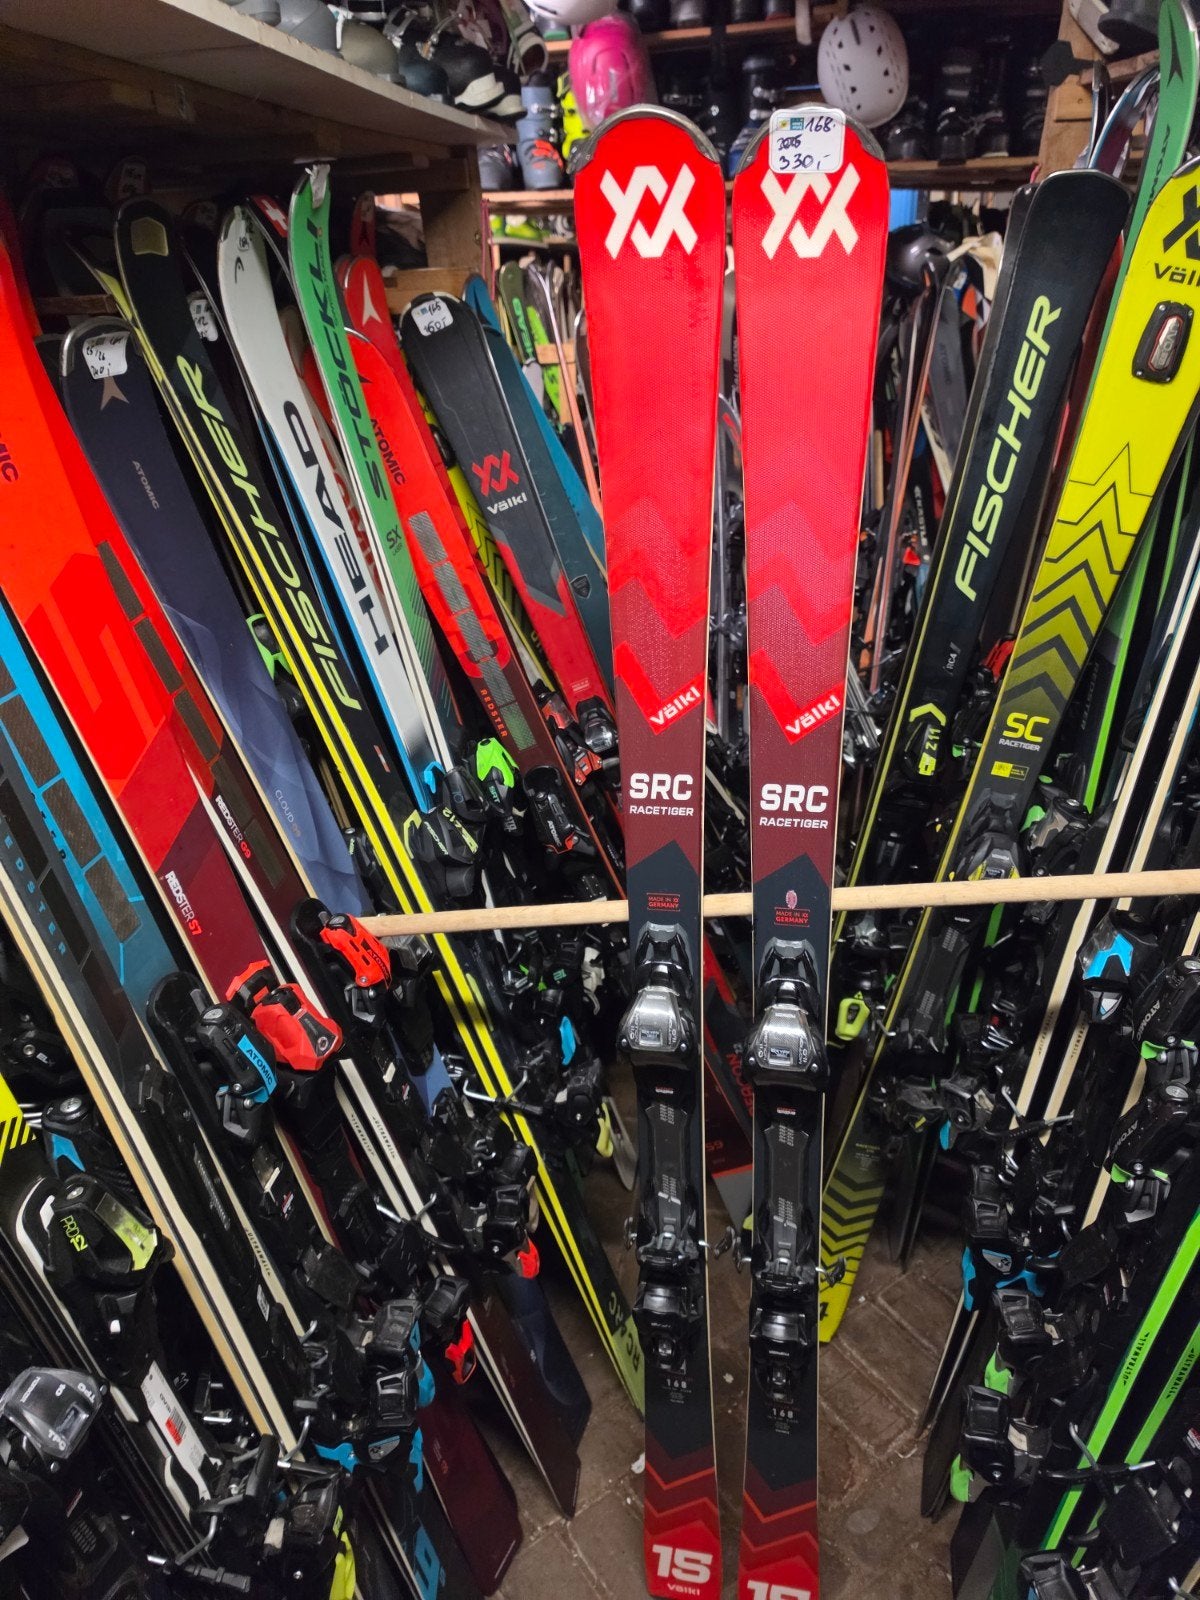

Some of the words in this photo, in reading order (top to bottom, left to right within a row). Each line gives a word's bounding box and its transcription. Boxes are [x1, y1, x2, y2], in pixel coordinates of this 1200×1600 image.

[1154, 262, 1200, 285] Völ
[306, 217, 388, 501] STÖCKLI
[370, 417, 406, 487] ATOMIC
[953, 294, 1062, 603] FISCHER
[131, 459, 161, 511] ATOMIC
[486, 491, 528, 516] Völkl
[175, 354, 363, 712] FISCHER
[282, 399, 390, 656] HEAD
[386, 524, 402, 550] SX
[480, 688, 508, 738] REDSTER
[649, 685, 701, 726] Völkl
[785, 694, 841, 735] Völkl
[998, 737, 1042, 753] RACETIGER
[1002, 711, 1051, 743] SC
[274, 788, 295, 823] CLOUD
[629, 772, 694, 801] SRC
[759, 783, 830, 813] SRC
[214, 794, 244, 844] REDSTER
[239, 841, 252, 859] G9
[629, 804, 695, 817] RACETIGER
[759, 816, 829, 830] RACETIGER
[0, 820, 67, 956] EDSTER
[164, 870, 195, 923] REDSTER
[187, 918, 203, 937] S7
[648, 901, 680, 910] GERMANY
[775, 916, 809, 925] GERMANY
[1137, 999, 1162, 1043] ATOMIC
[246, 1047, 273, 1086] ATOMIC
[248, 1230, 271, 1274] ULTRAWALL
[1123, 1337, 1147, 1381] ULTRAWALL
[1169, 1353, 1195, 1396] ULTRAWALL
[665, 1378, 688, 1390] 168
[772, 1407, 794, 1420] 168
[651, 1544, 714, 1585] 15
